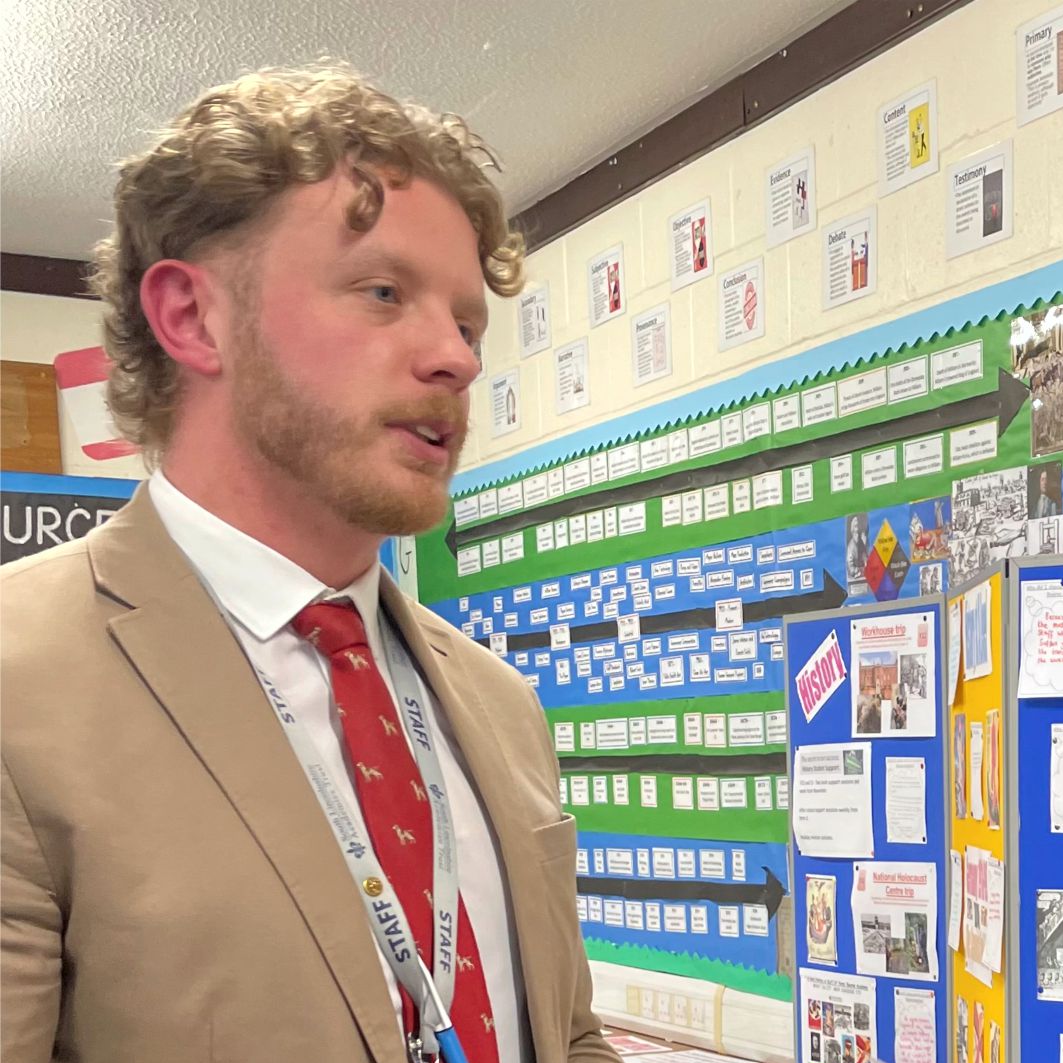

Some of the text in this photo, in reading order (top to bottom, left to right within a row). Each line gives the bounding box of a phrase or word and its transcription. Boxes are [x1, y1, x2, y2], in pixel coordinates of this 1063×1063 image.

[1025, 26, 1052, 47] Primary
[883, 104, 906, 124] Content
[770, 168, 791, 186] Evidence
[954, 165, 987, 186] Testimony
[828, 231, 847, 246] Debate
[723, 273, 747, 290] Conclusion
[861, 624, 906, 638] Workhouse trip
[797, 640, 845, 715] History
[404, 696, 432, 752] STAFF
[873, 871, 928, 883] National Holocaust
[372, 900, 411, 964] STAFF
[439, 909, 453, 965] STAFF
